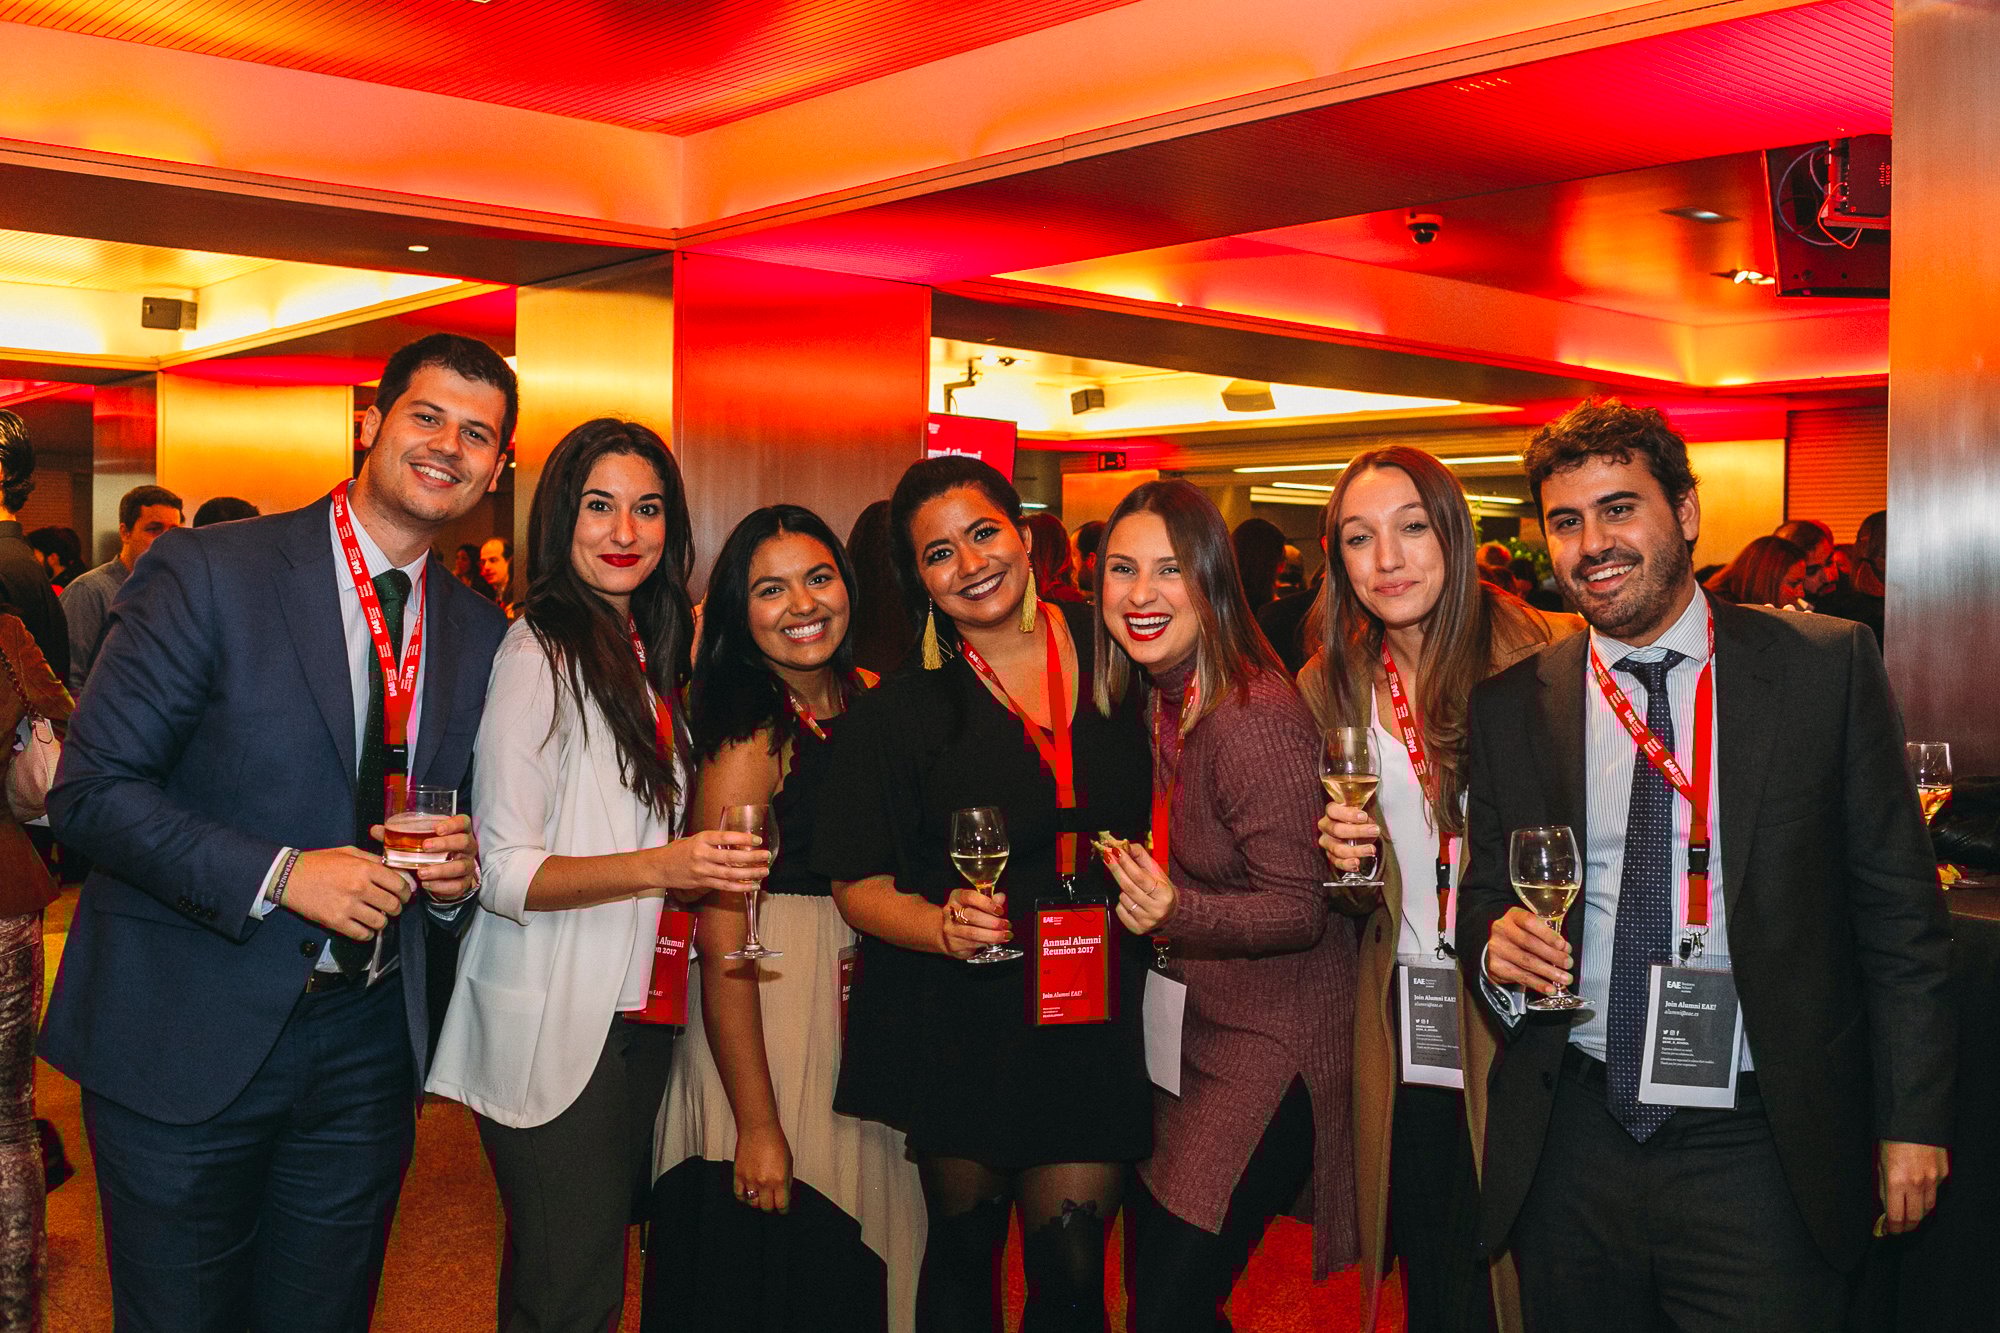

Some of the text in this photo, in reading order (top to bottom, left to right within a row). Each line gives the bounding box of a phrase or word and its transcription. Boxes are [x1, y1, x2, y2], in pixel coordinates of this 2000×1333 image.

[335, 503, 344, 518] EAE
[351, 559, 363, 575] EAE
[370, 619, 383, 635] EAE
[968, 650, 980, 664] EAE
[405, 665, 415, 679] EAE
[387, 680, 398, 697] EAE
[1390, 682, 1400, 698] EAE
[1624, 709, 1636, 725] EAE
[1406, 737, 1418, 754] EAE
[1663, 758, 1680, 776] EAE
[1042, 916, 1054, 924] EAE
[659, 936, 685, 948] Alumni
[1042, 934, 1102, 948] Annual Alumni
[662, 947, 677, 957] 2017
[1042, 945, 1095, 957] Reunion 2017
[1413, 977, 1426, 985] EAE
[1666, 980, 1682, 990] EAE
[1042, 992, 1053, 1000] Join
[1424, 994, 1444, 1002] Alumni
[1665, 1000, 1678, 1008] Join
[1677, 1001, 1701, 1010] Alumni
